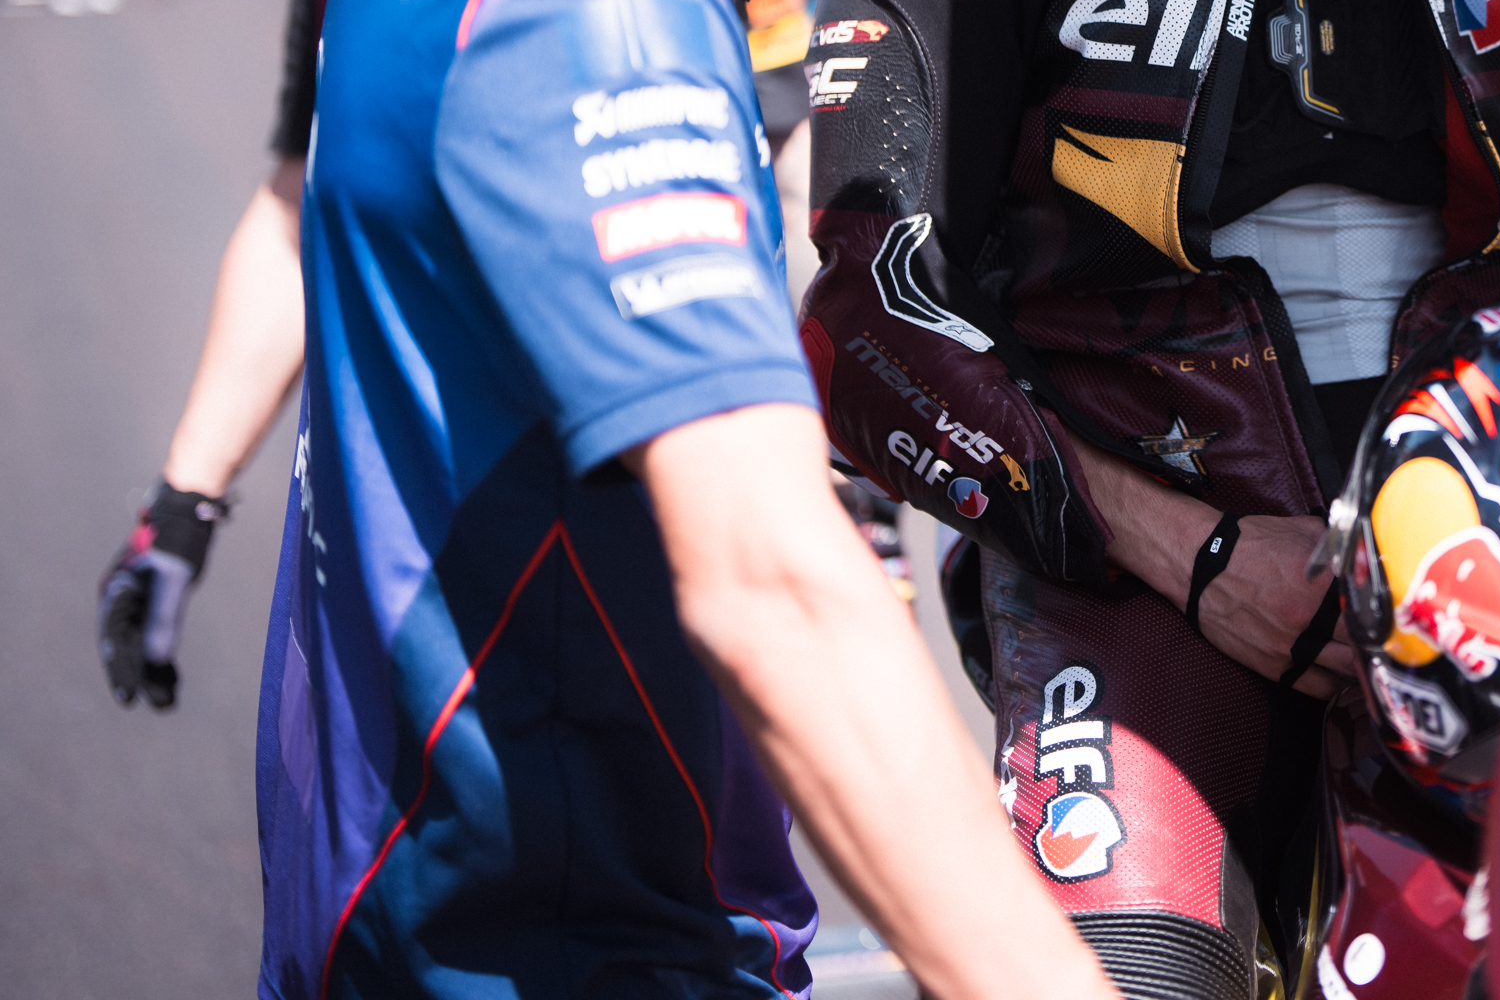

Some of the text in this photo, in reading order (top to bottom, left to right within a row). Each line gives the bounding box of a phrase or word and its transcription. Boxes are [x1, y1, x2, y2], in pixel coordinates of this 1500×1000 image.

[862, 330, 949, 408] RACING TEAM
[887, 429, 954, 486] elf
[1040, 665, 1107, 784] elf
